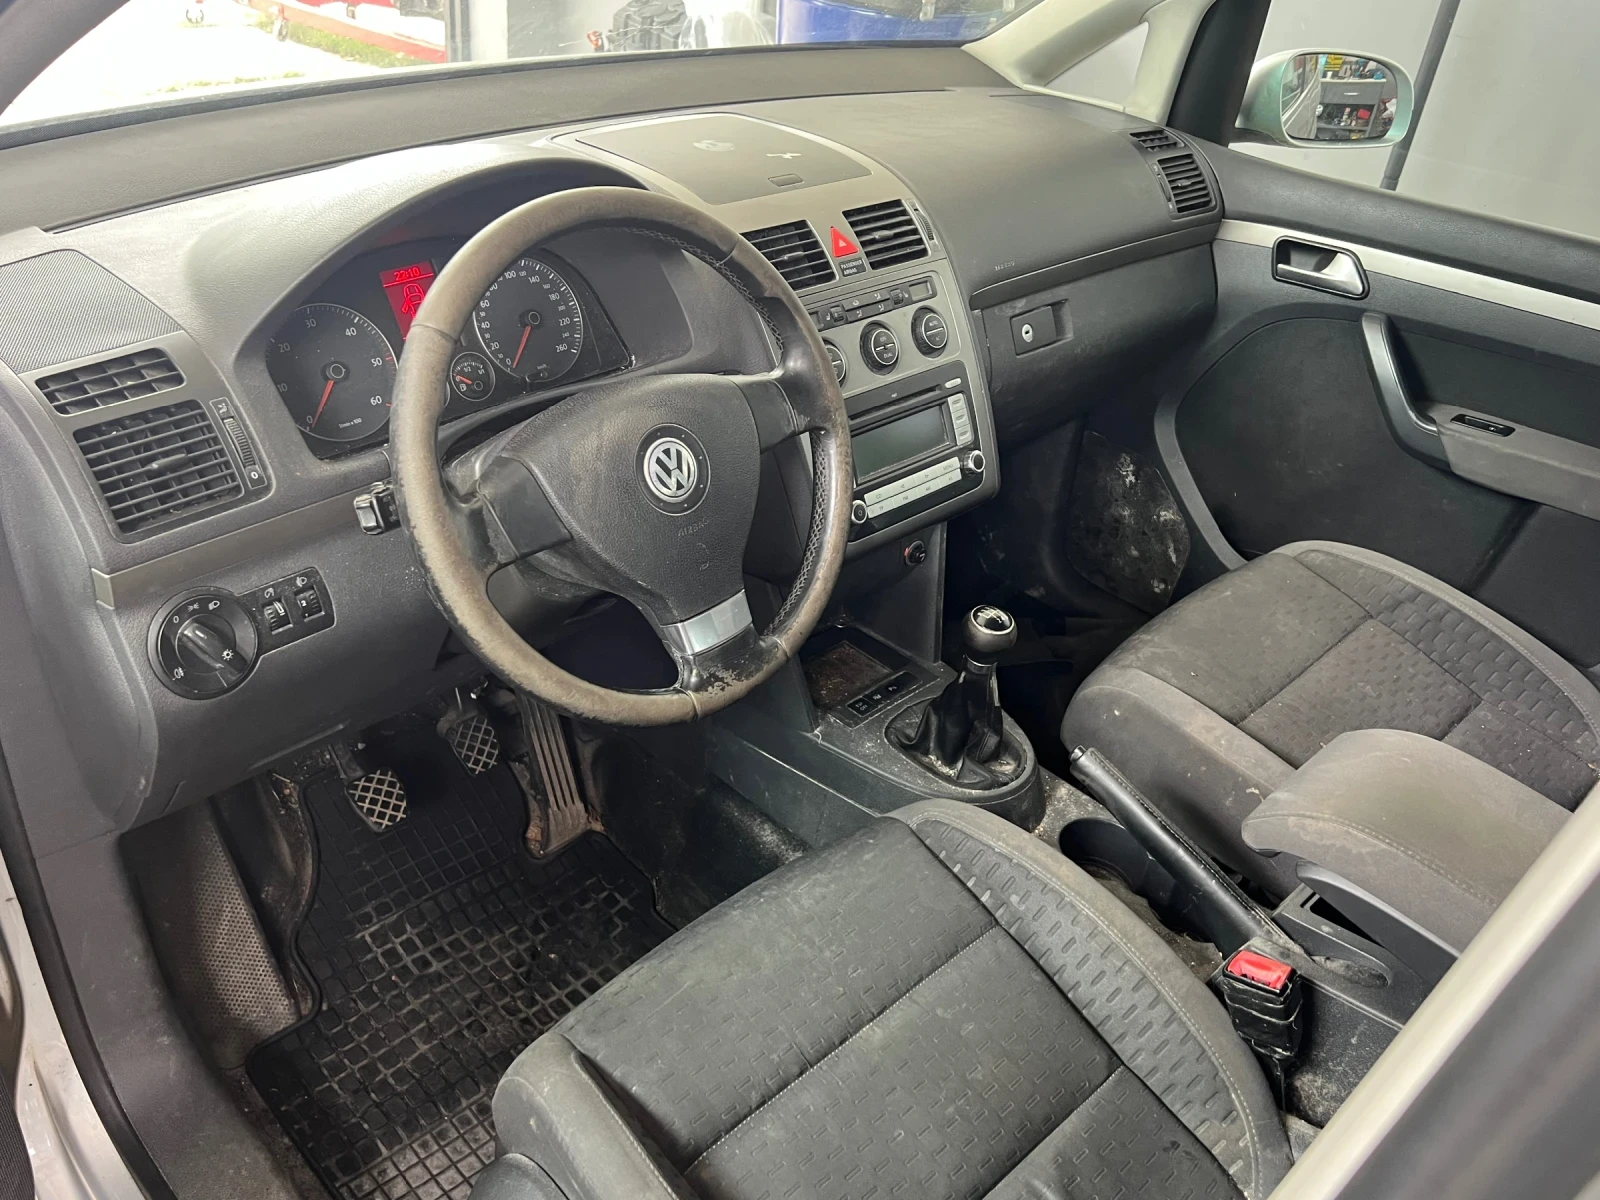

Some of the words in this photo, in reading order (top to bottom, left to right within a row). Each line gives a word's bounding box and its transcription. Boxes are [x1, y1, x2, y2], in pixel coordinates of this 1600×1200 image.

[393, 267, 420, 281] 22:10
[504, 270, 516, 279] 100
[528, 275, 540, 284] 140
[548, 292, 560, 301] 180
[480, 300, 490, 308] 60
[305, 318, 317, 329] 30
[481, 321, 490, 329] 40
[559, 317, 571, 327] 220
[345, 327, 357, 337] 40
[278, 342, 290, 352] 20
[490, 341, 500, 351] 20
[555, 343, 568, 353] 260
[371, 357, 382, 367] 50
[505, 358, 512, 366] 0
[276, 382, 288, 392] 10
[370, 395, 382, 405] 60
[306, 415, 313, 424] 0
[678, 517, 709, 536] AIRBAG
[173, 615, 180, 624] 0
